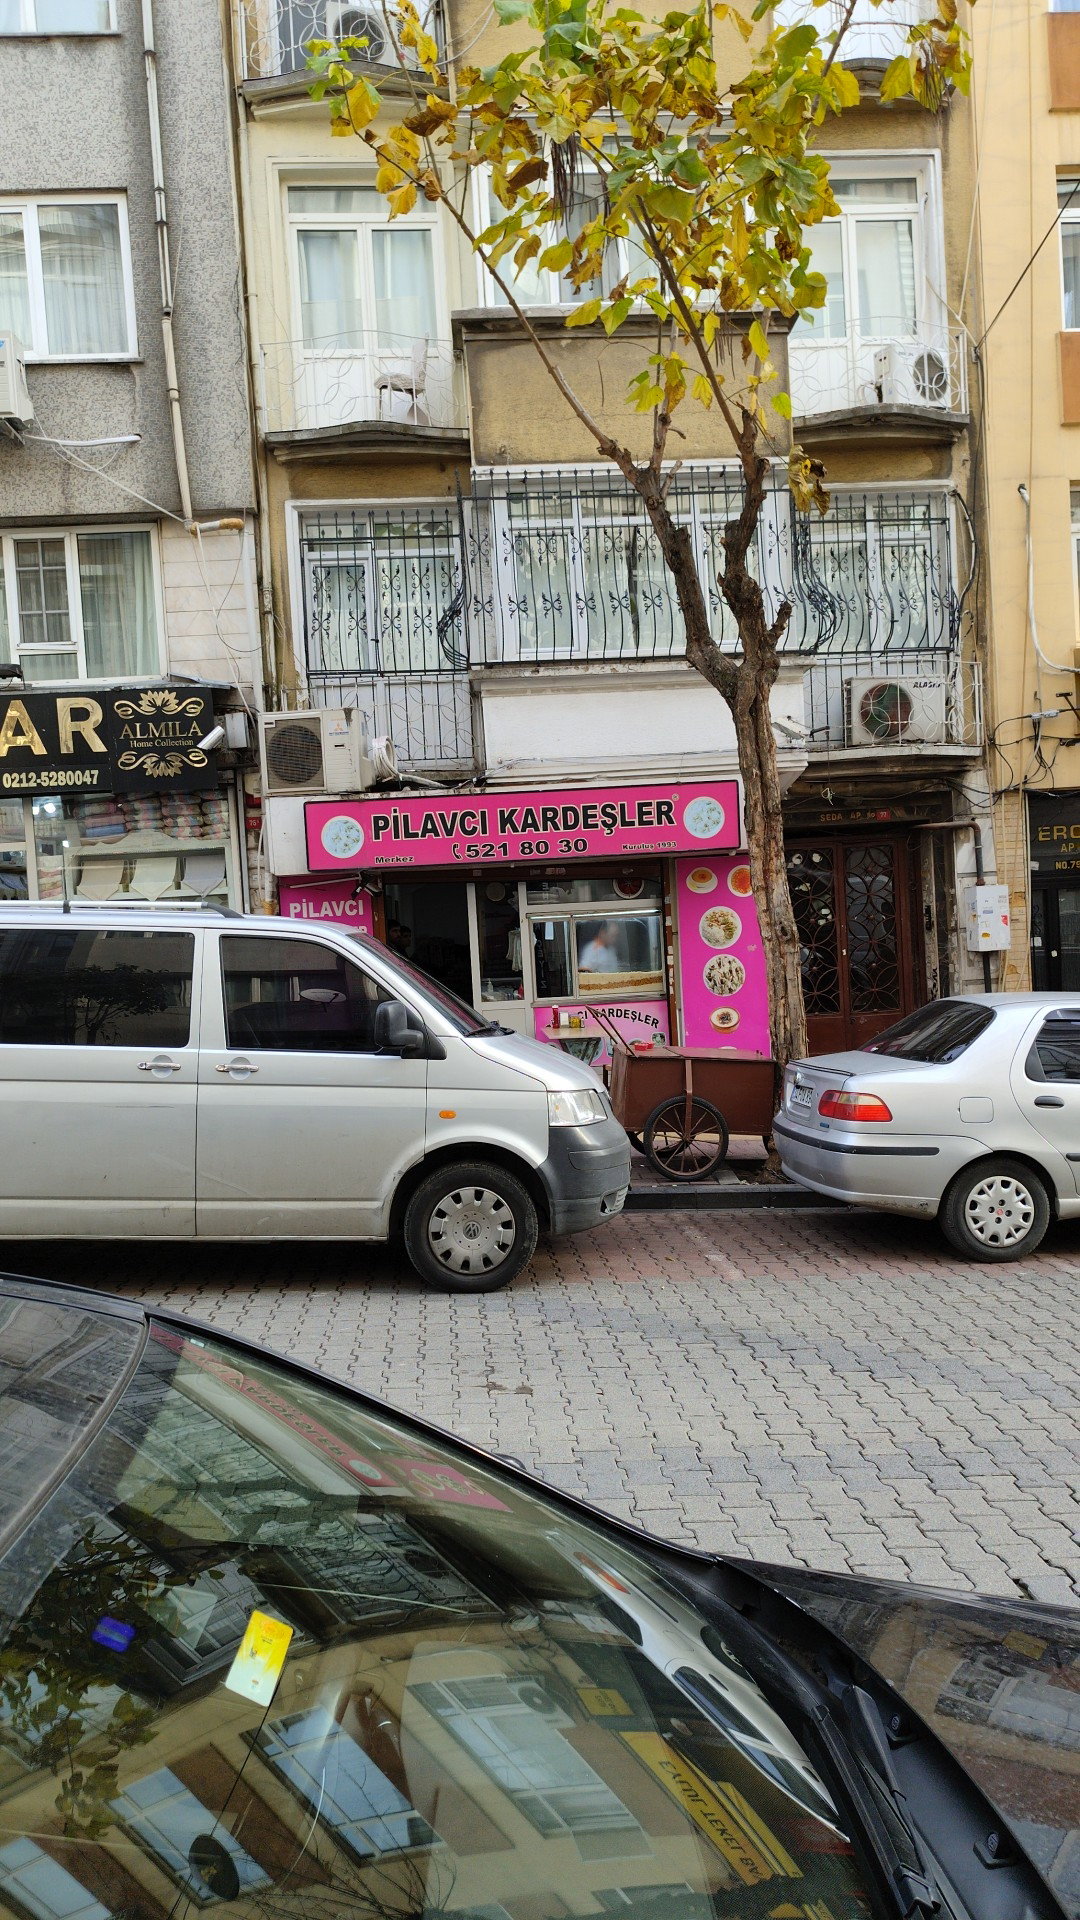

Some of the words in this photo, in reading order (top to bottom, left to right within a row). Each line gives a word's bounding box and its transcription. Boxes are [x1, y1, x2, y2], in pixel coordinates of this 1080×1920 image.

[0, 696, 108, 757] AR
[119, 720, 204, 740] ALMILA
[130, 739, 153, 748] Home
[154, 737, 194, 747] Collection
[2, 768, 99, 789] 0212-5280047
[371, 806, 489, 842] PİLAVCI
[496, 798, 678, 837] KARDEŞLER
[820, 813, 843, 822] SEDA
[465, 841, 510, 859] 521
[519, 839, 551, 857] 80
[557, 837, 589, 855] 30
[656, 840, 678, 850] 1993
[374, 855, 415, 865] Merkez
[289, 898, 364, 918] PİLAVCI
